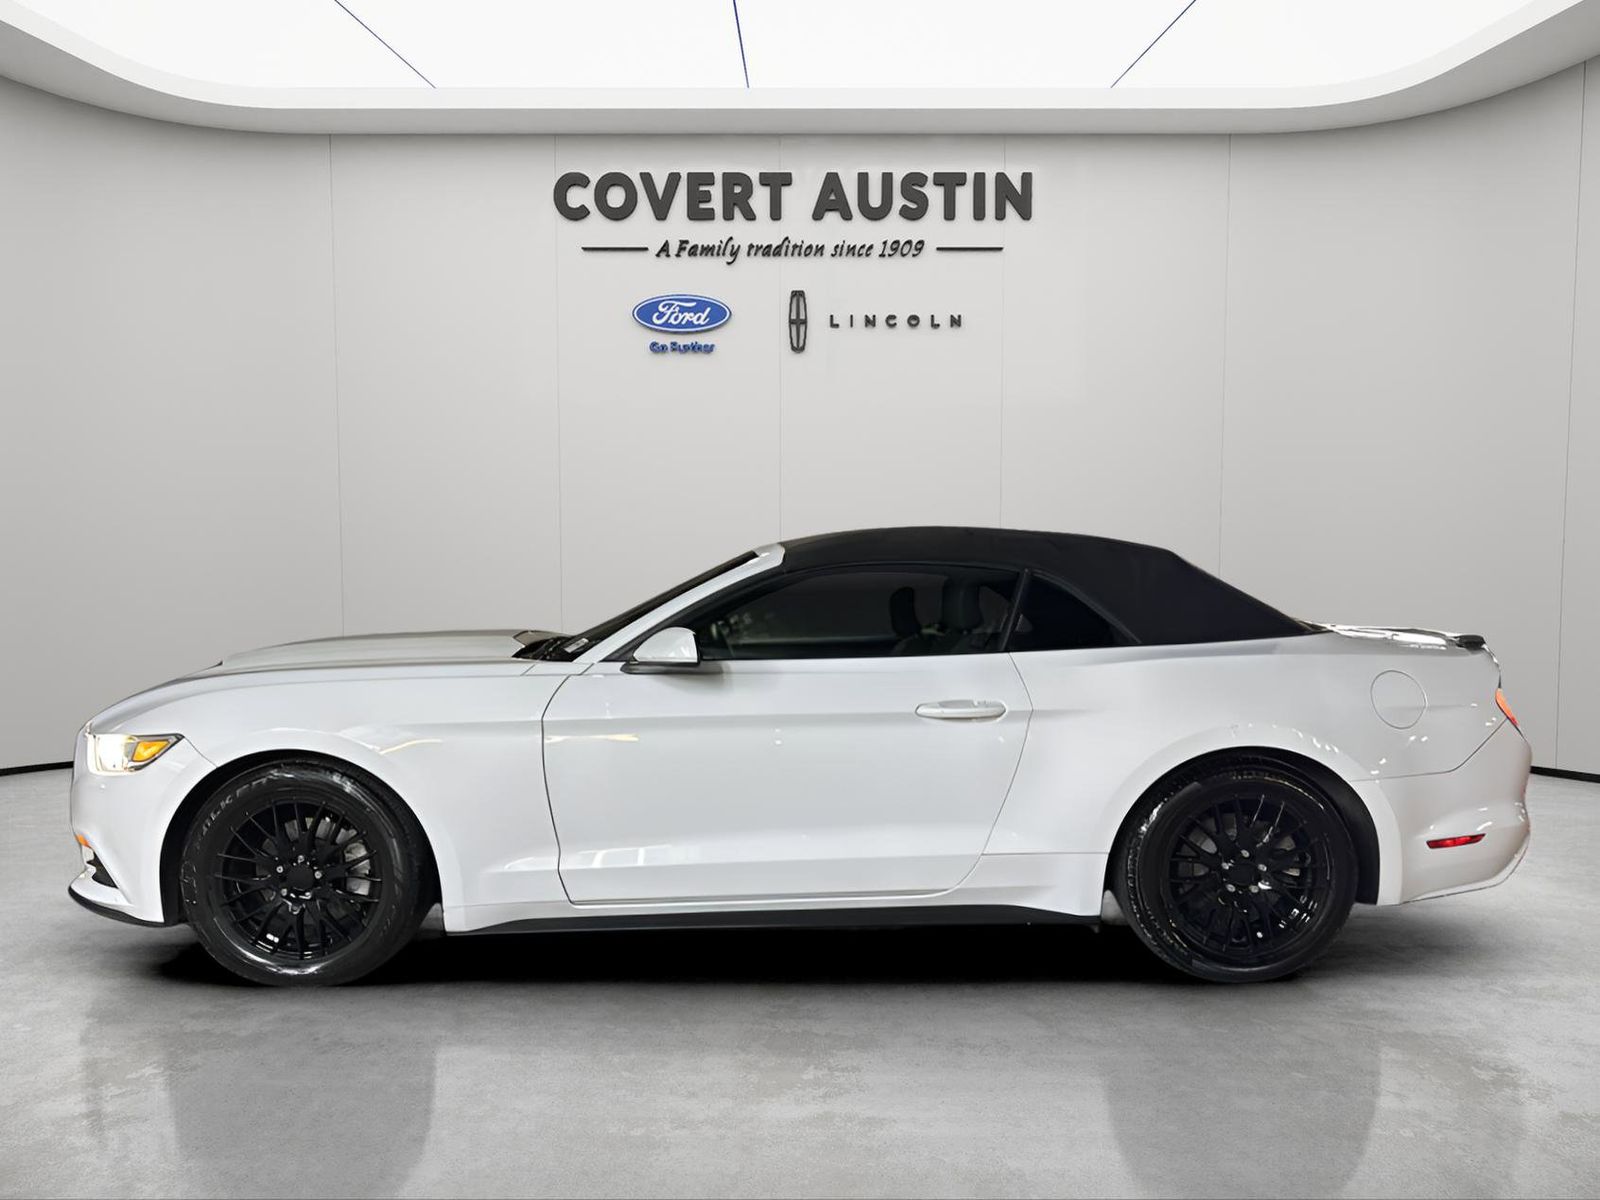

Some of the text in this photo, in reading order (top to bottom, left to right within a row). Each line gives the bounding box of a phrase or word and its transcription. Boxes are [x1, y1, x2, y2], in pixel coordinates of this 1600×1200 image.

[553, 171, 1033, 222] COVERT AUSTIN
[655, 236, 926, 266] A Family tradition since 1909
[652, 300, 711, 325] Ford
[829, 313, 963, 329] LINCOLN
